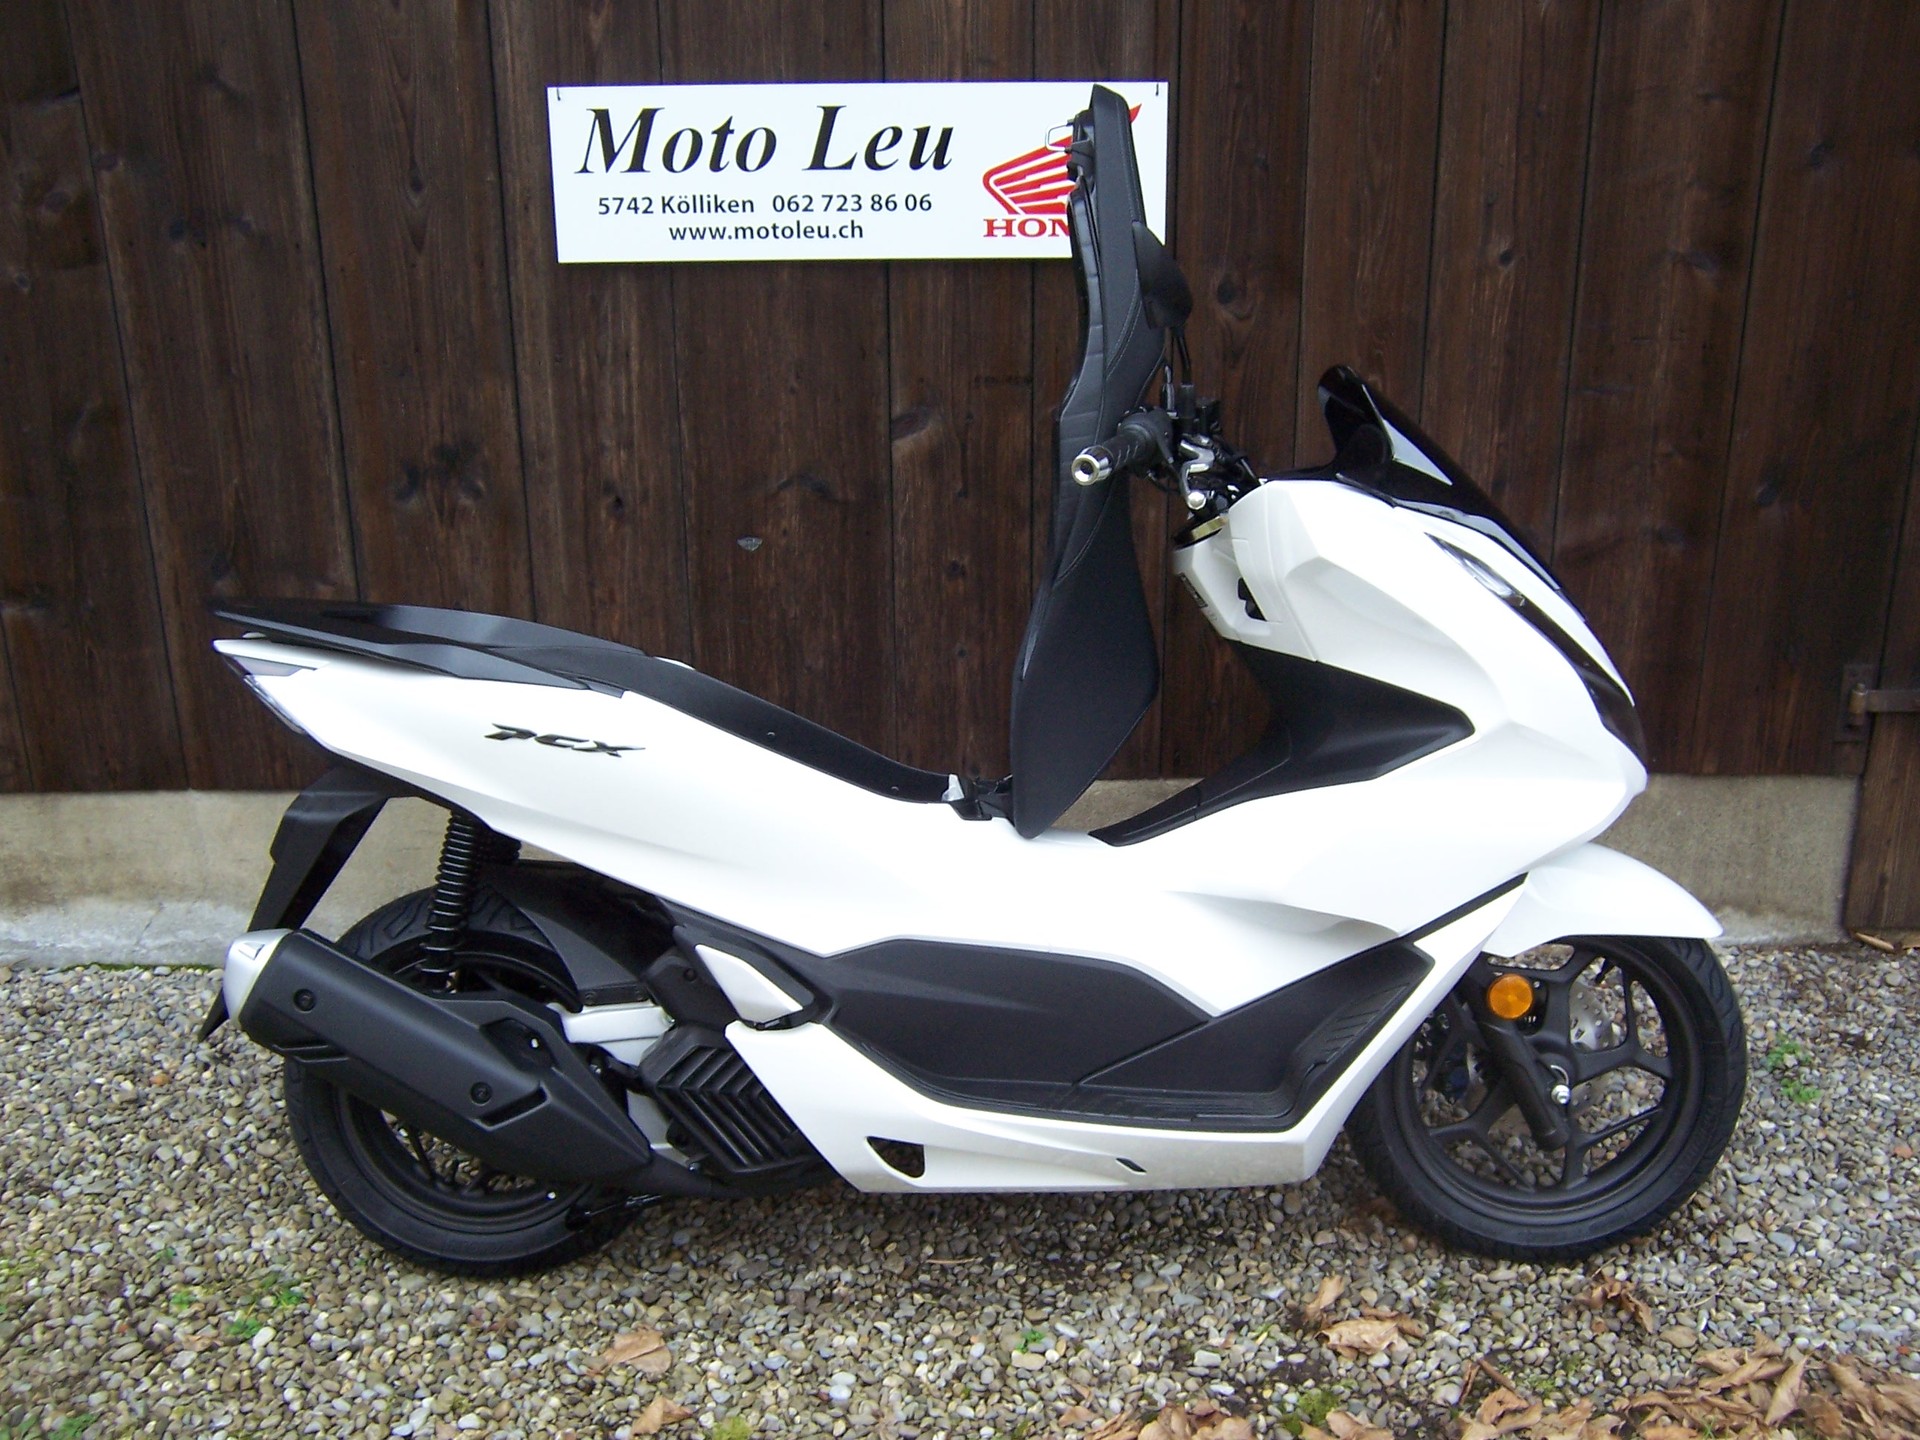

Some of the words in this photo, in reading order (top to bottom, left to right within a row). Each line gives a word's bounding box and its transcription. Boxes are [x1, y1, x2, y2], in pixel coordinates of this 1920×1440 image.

[574, 106, 777, 174] Moto
[802, 104, 954, 172] Leu
[598, 196, 654, 215] 5742
[661, 194, 755, 214] Kölliken
[772, 194, 814, 213] 062
[821, 194, 863, 212] 723
[870, 193, 898, 212] 86
[904, 193, 932, 212] 06
[668, 219, 864, 241] www.motoleu.ch
[983, 217, 1071, 238] HON
[484, 722, 646, 758] PCX
